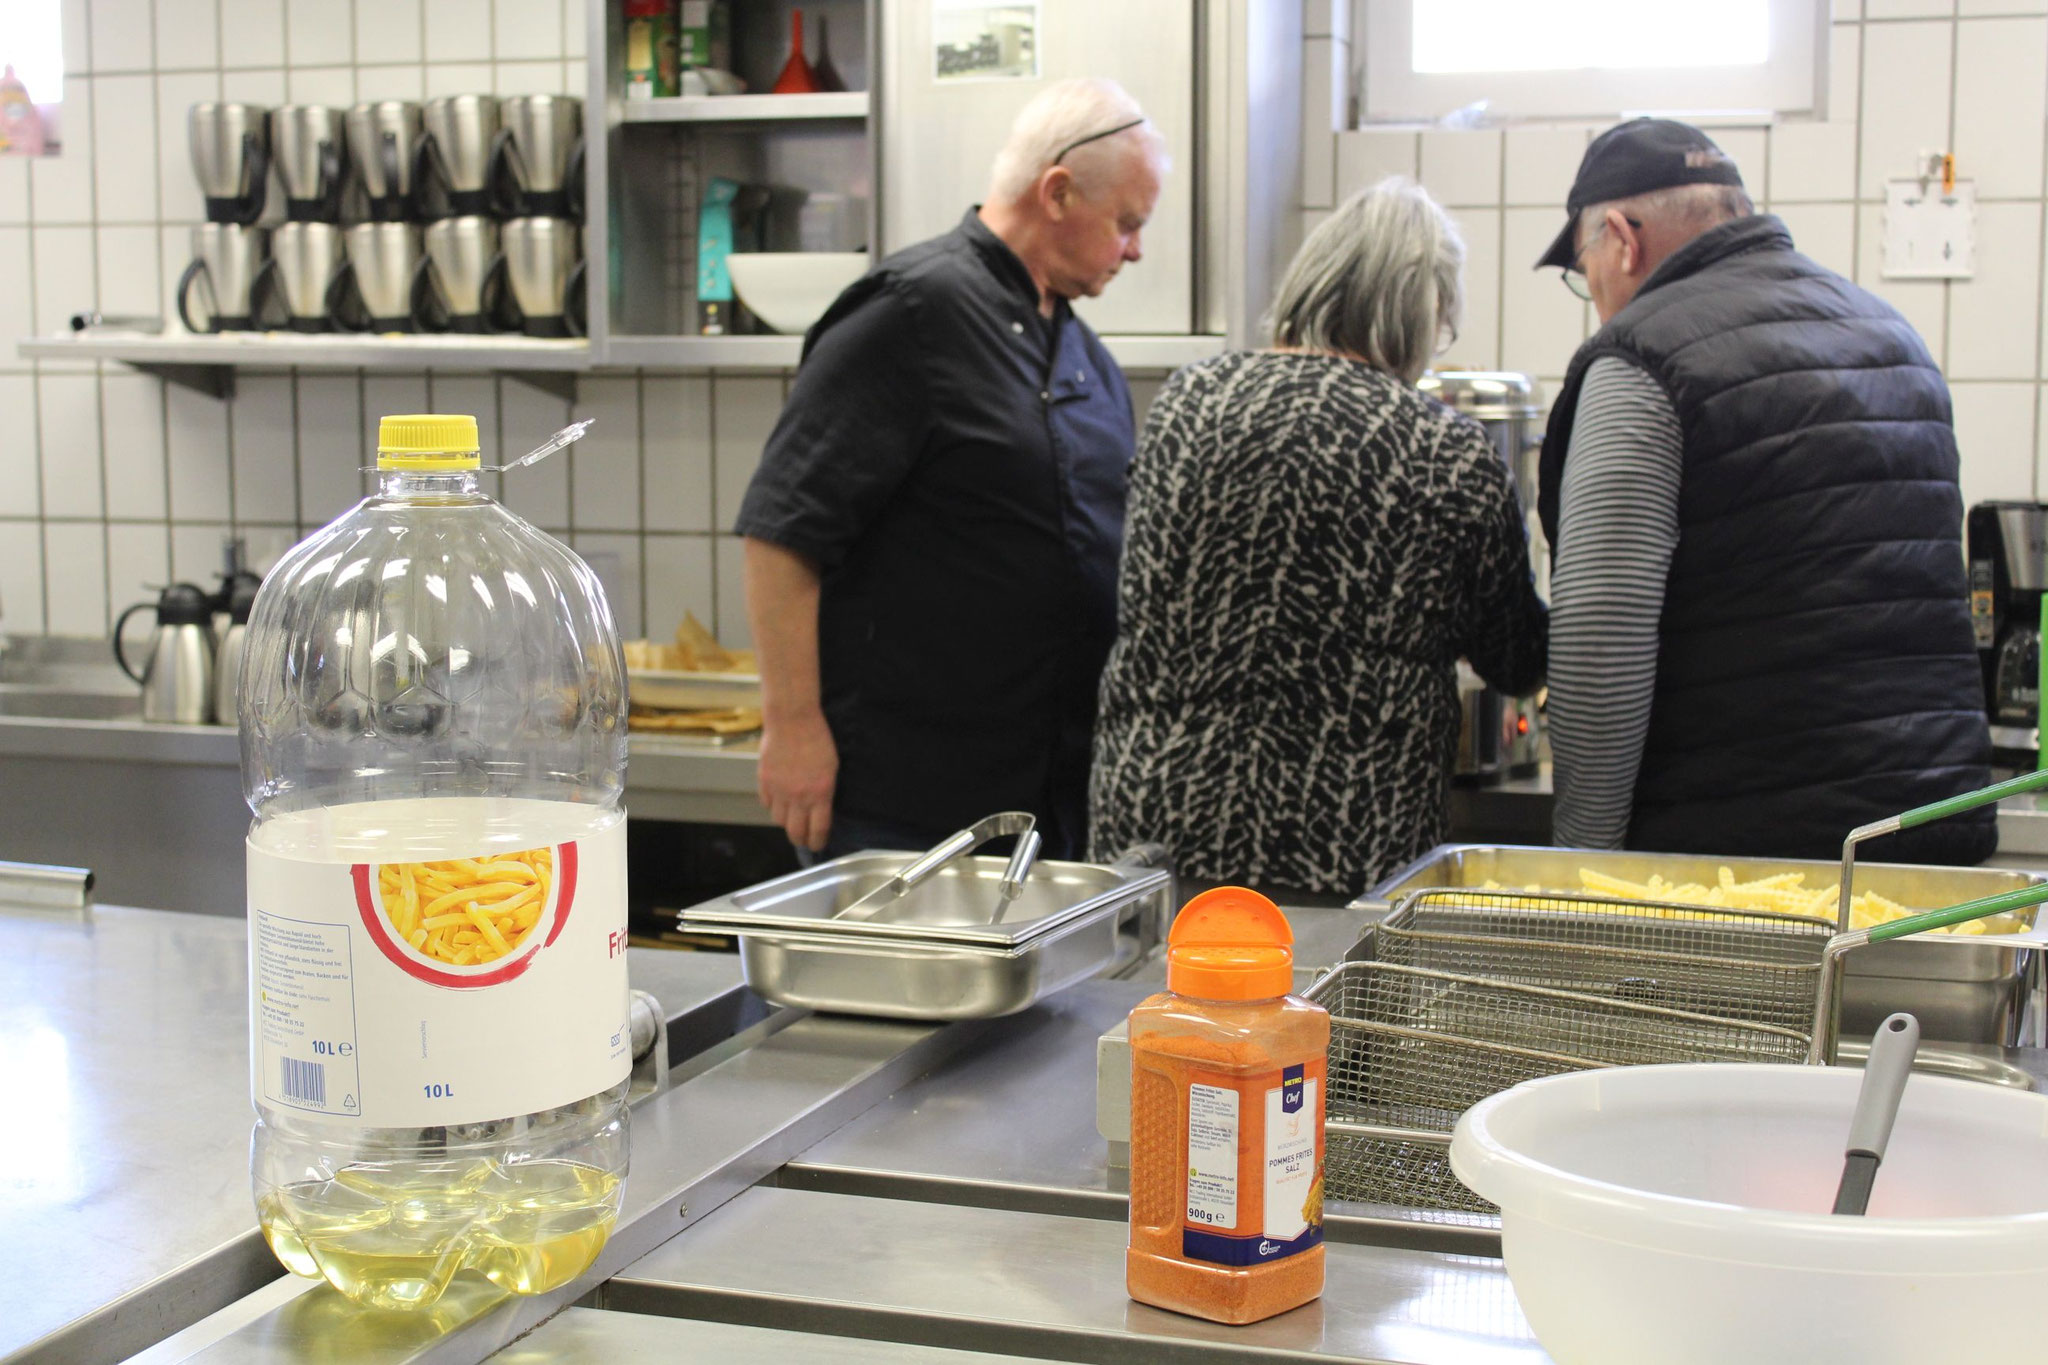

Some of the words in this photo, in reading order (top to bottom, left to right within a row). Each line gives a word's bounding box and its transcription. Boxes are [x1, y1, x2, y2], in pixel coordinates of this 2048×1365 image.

[312, 1040, 325, 1054] 10
[328, 1042, 335, 1056] L
[1284, 1076, 1303, 1087] METRO
[423, 1084, 442, 1099] 10
[445, 1083, 454, 1097] L
[1286, 1090, 1301, 1105] Chef
[1269, 1153, 1295, 1168] POMMES
[1295, 1148, 1314, 1161] FRITES
[1285, 1162, 1300, 1174] SALZ
